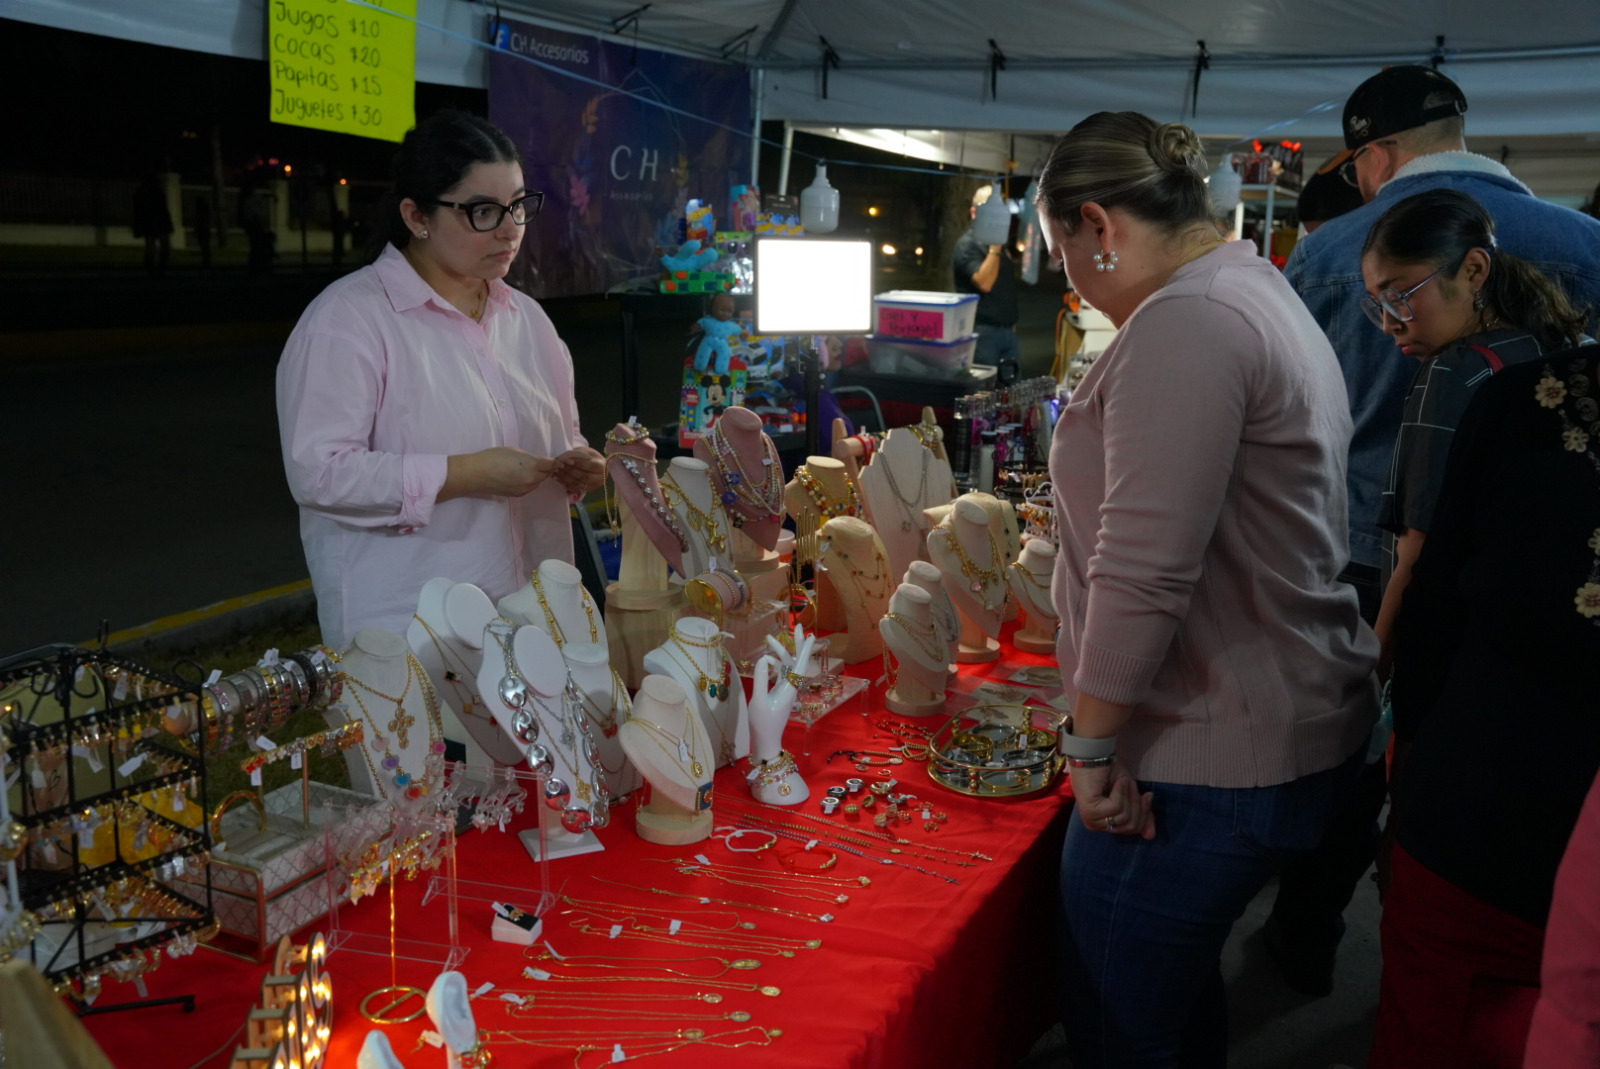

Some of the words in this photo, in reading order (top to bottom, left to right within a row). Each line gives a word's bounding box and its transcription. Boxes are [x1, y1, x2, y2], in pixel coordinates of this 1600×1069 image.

[275, 1, 339, 38] Jugos
[350, 18, 380, 38] $10
[274, 33, 335, 65] Cocas
[350, 46, 380, 68] $20
[510, 32, 528, 52] CH
[529, 37, 590, 64] Accesorios
[274, 60, 339, 91] Papitas
[351, 76, 382, 97] $15
[275, 89, 344, 121] Juguetes
[352, 105, 382, 126] $30
